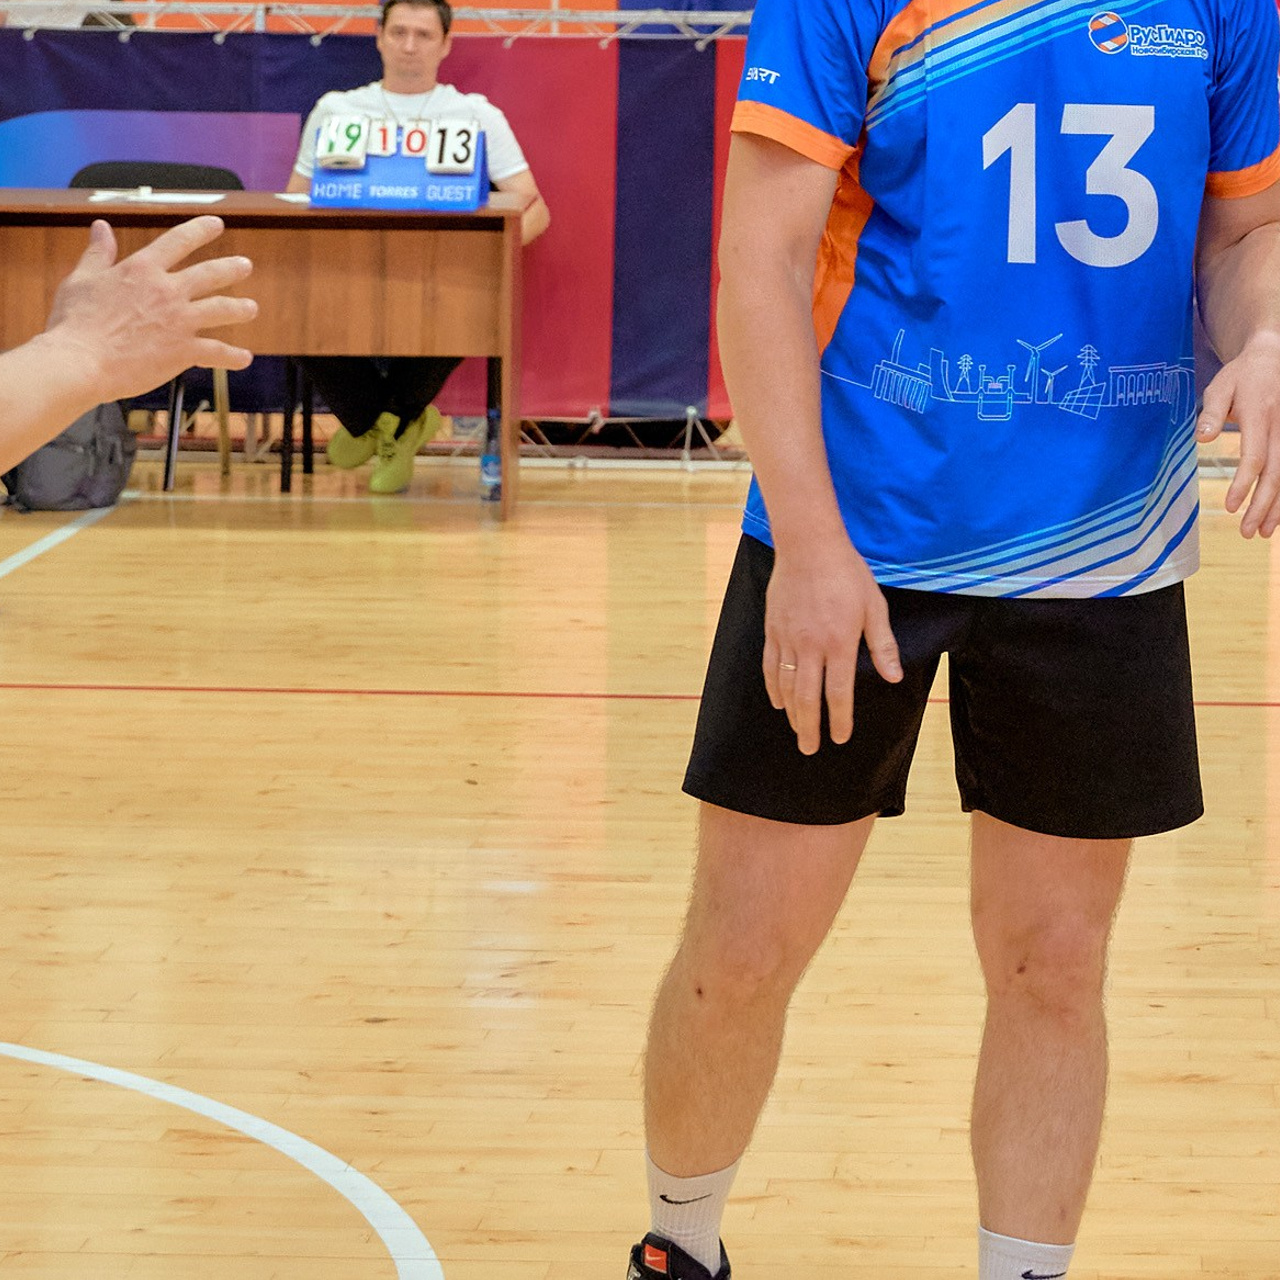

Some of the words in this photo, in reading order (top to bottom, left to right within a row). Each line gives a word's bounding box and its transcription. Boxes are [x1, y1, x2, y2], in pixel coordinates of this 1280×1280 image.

[379, 128, 389, 151] 1
[406, 129, 427, 153] 0
[437, 128, 471, 164] 13
[314, 182, 363, 200] HOME
[369, 184, 419, 198] TORRES
[426, 184, 476, 201] GUEST
[982, 103, 1159, 268] 13
